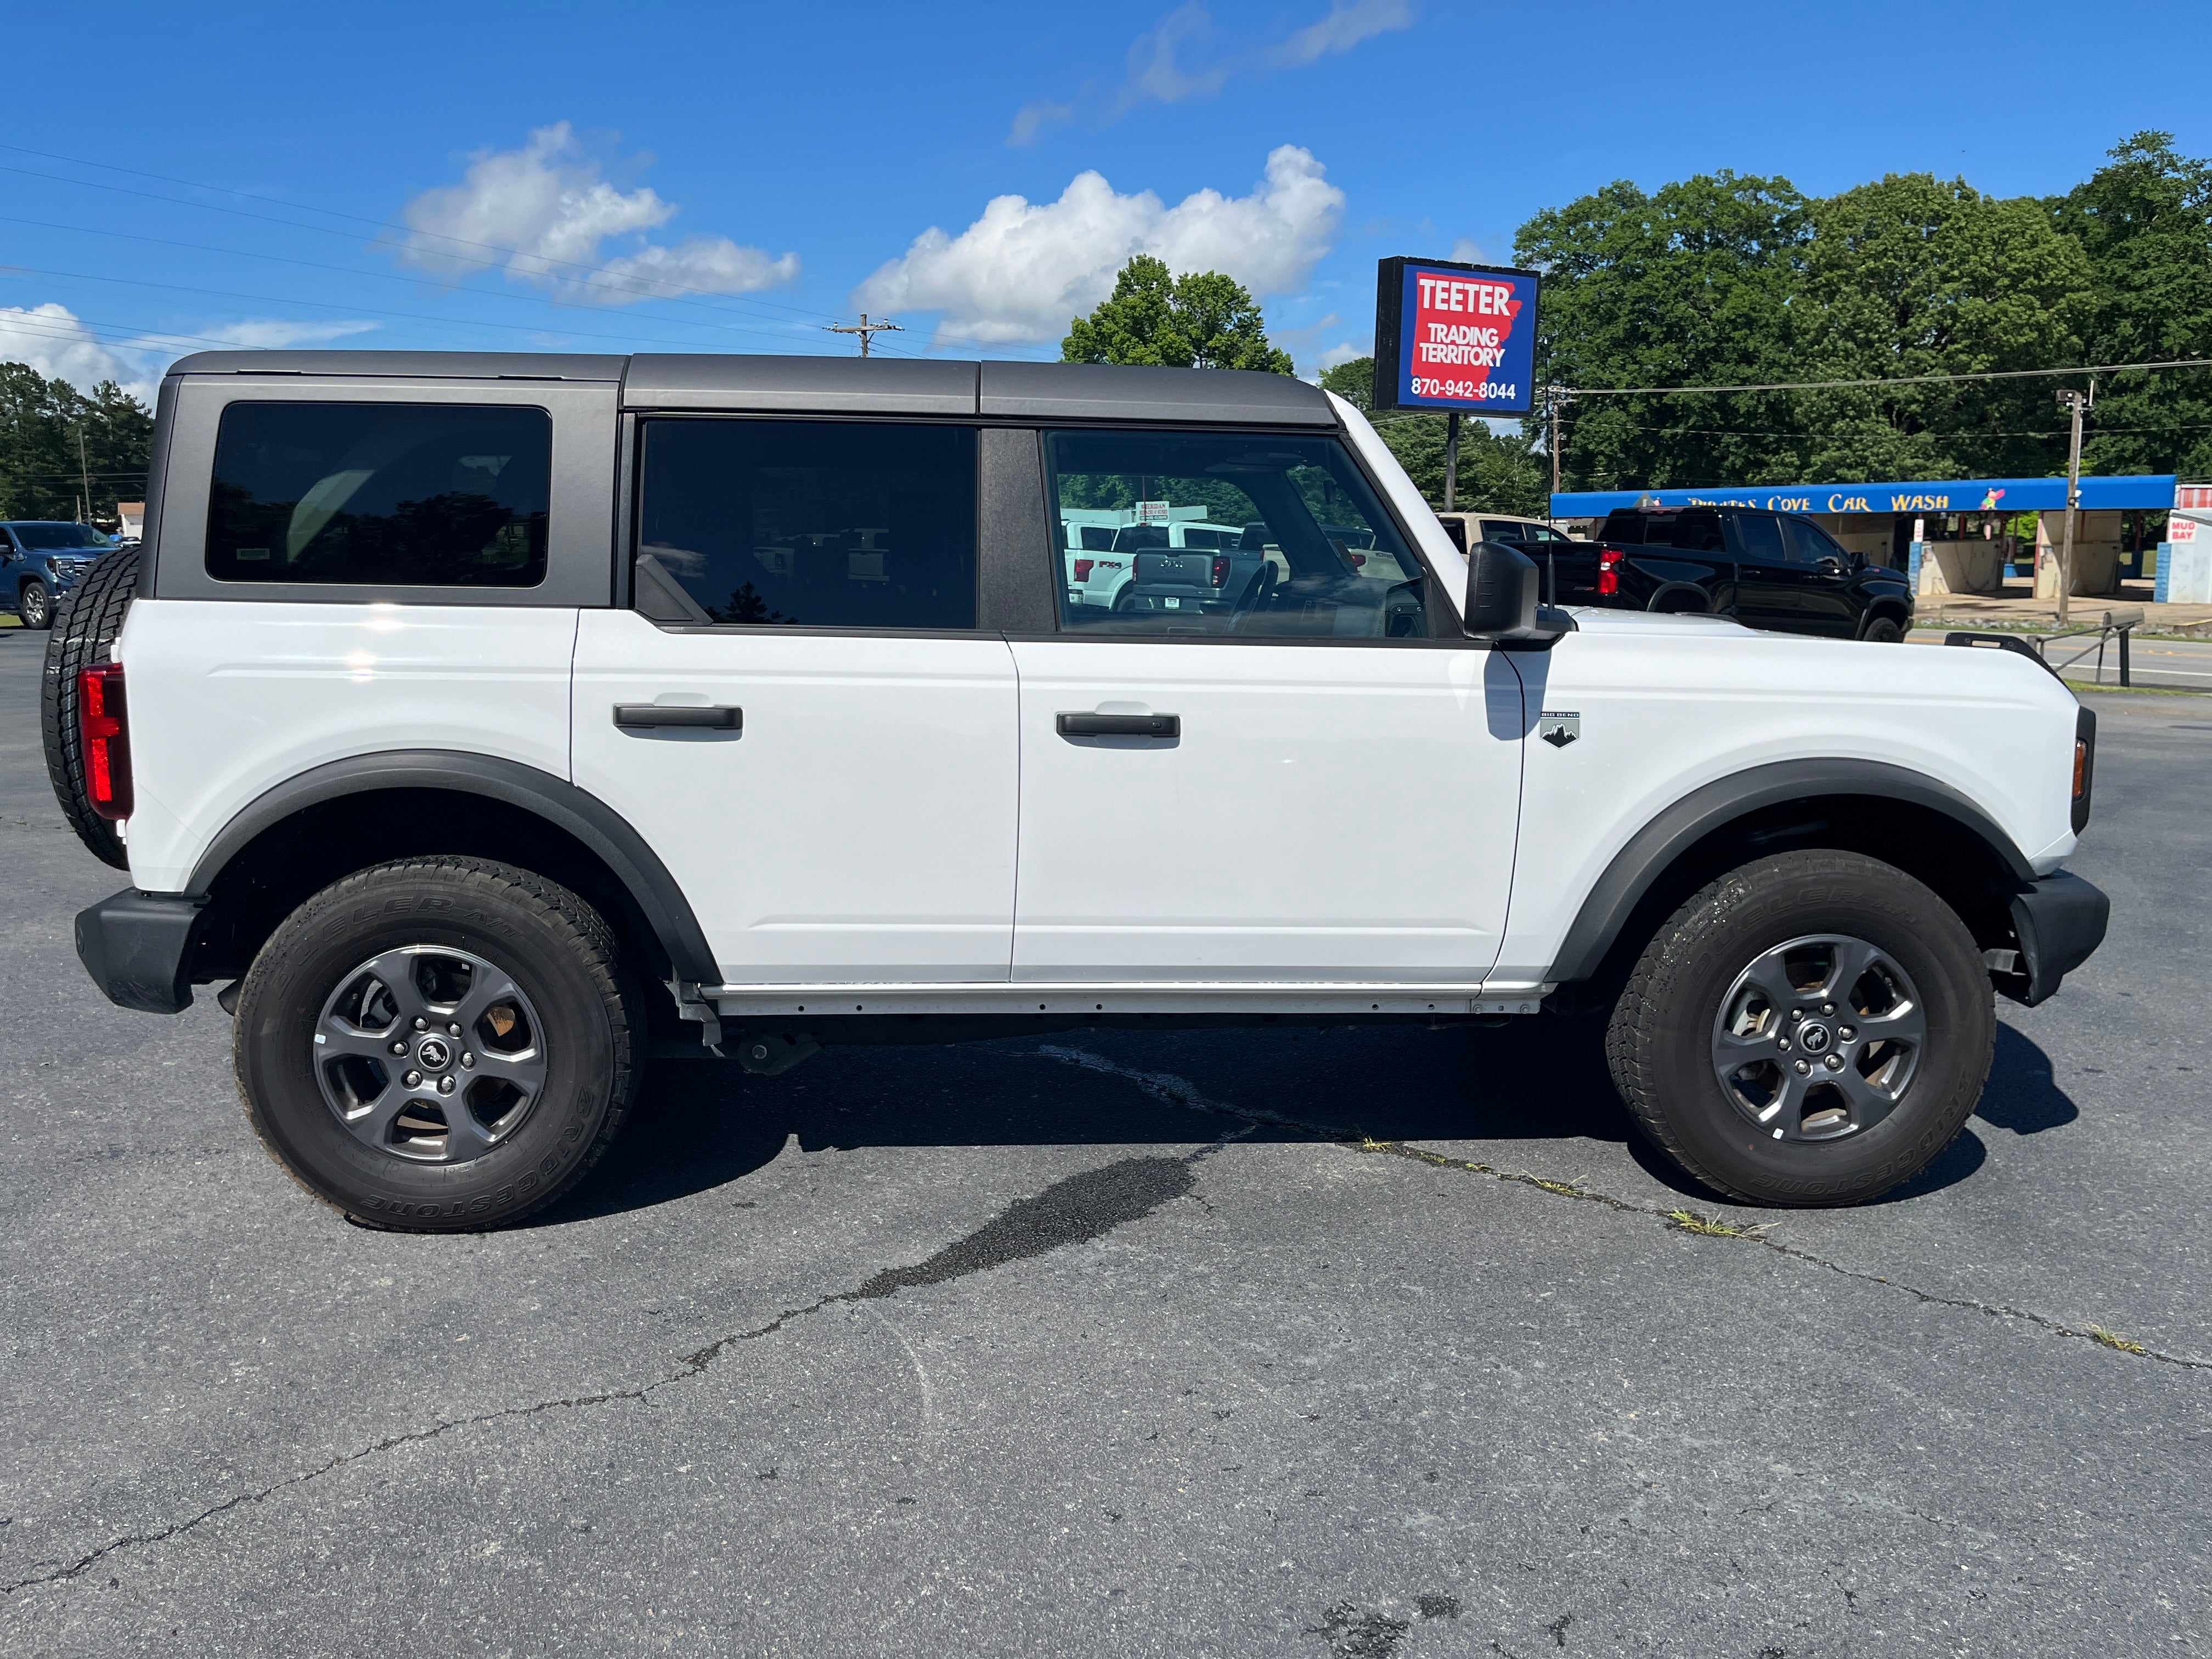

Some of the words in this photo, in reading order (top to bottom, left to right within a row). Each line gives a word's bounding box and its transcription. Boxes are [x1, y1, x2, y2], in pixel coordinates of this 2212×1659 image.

[1419, 278, 1510, 317] TEETER
[1427, 323, 1499, 347] TRADING
[1419, 342, 1505, 367] TERRITORY
[1411, 377, 1516, 399] 870-942-8044
[1828, 493, 1873, 512] CAR
[1891, 494, 1949, 511] WASH
[2172, 521, 2196, 530] MUD
[463, 909, 524, 940] A/T
[1752, 1066, 1969, 1195] BRIDGESTONE
[361, 1084, 595, 1217] BRIDGESTONE
